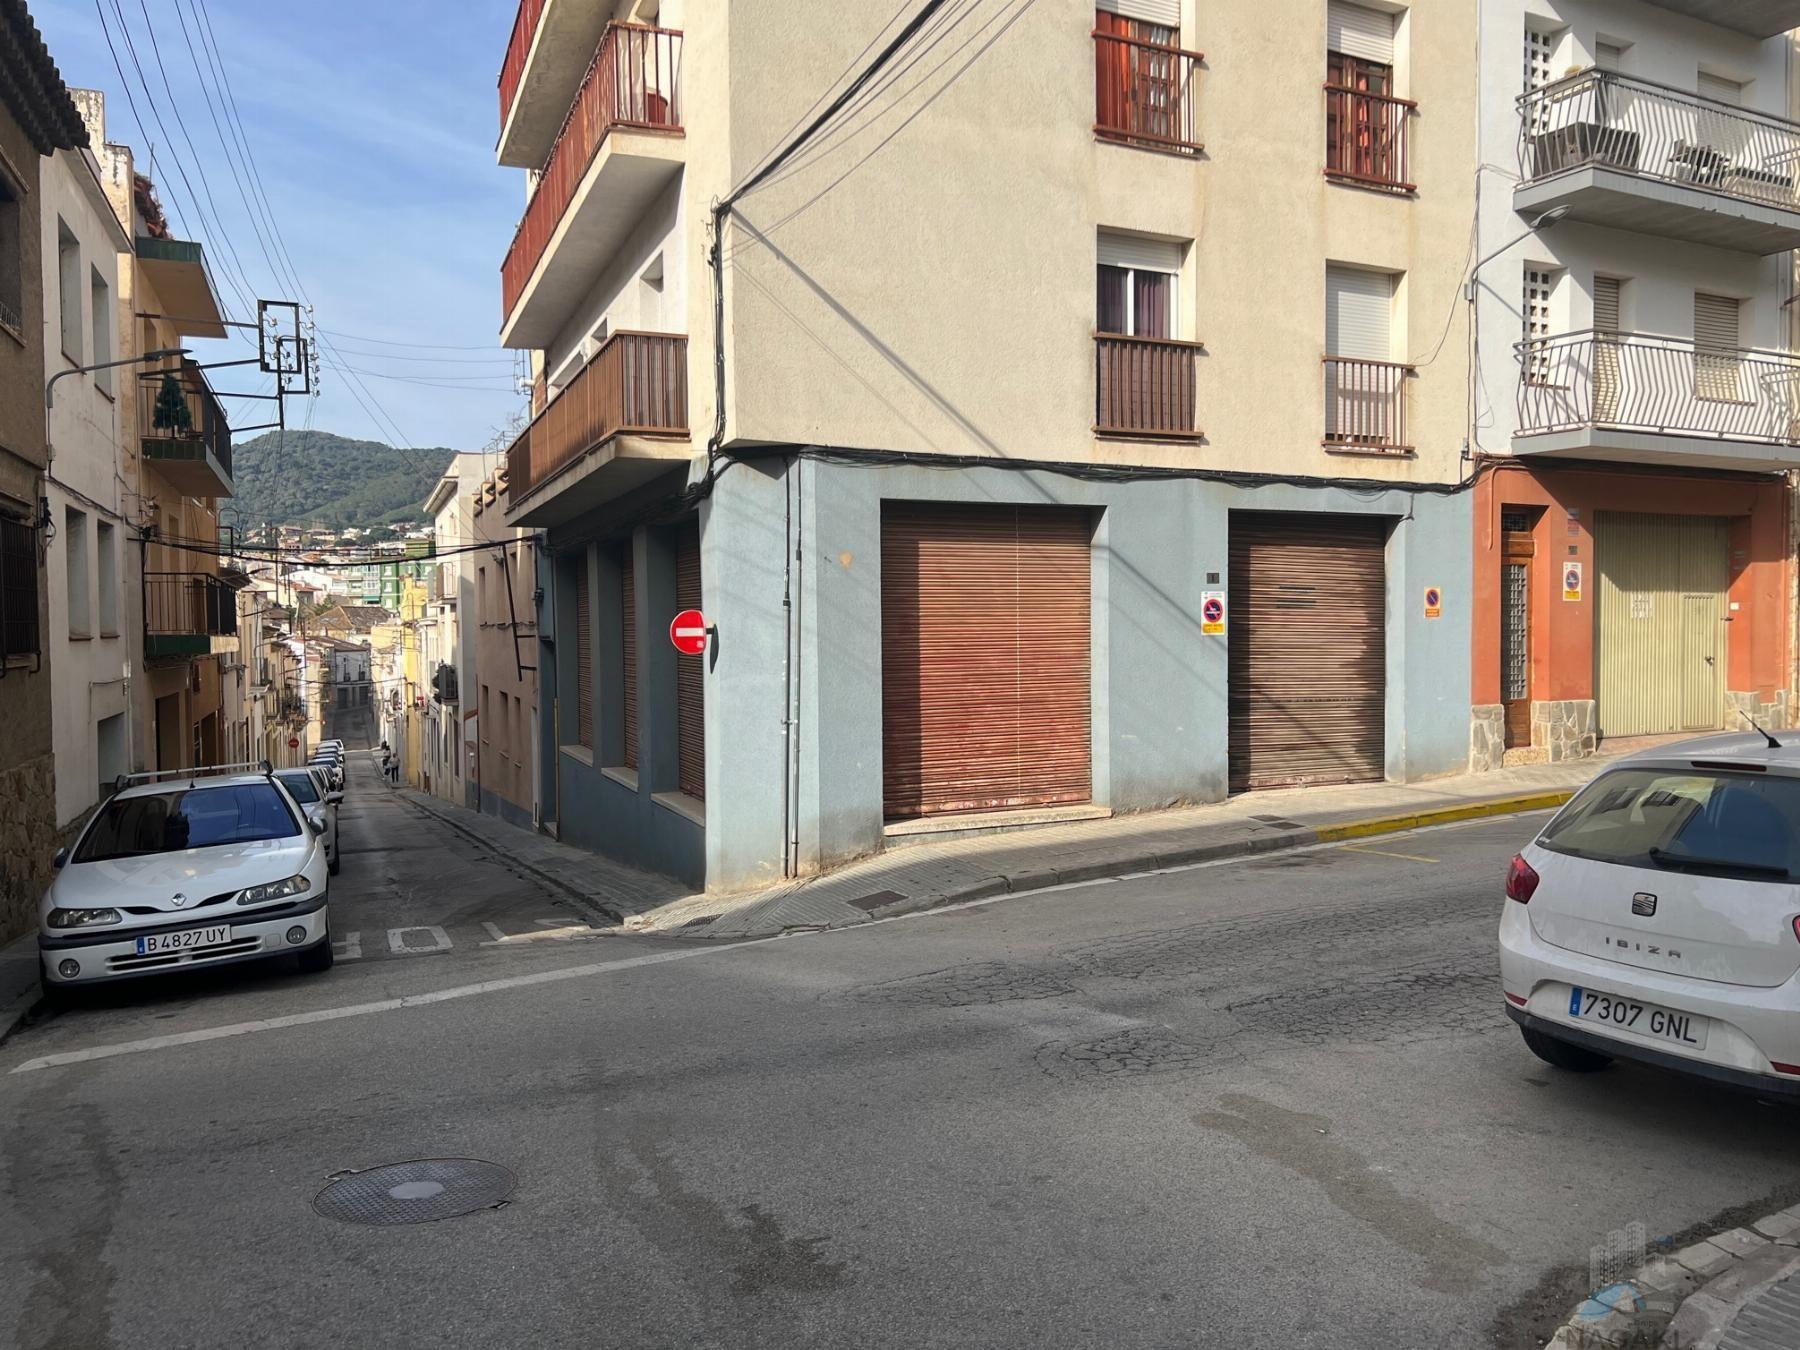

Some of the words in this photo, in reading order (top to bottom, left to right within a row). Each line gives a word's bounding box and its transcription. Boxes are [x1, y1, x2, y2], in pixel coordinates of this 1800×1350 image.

[147, 937, 157, 952] B
[161, 931, 202, 949] 4827
[206, 927, 226, 943] UY
[1605, 936, 1681, 959] IBIZA
[1584, 993, 1644, 1027] 7307
[1650, 1010, 1697, 1044] GNL
